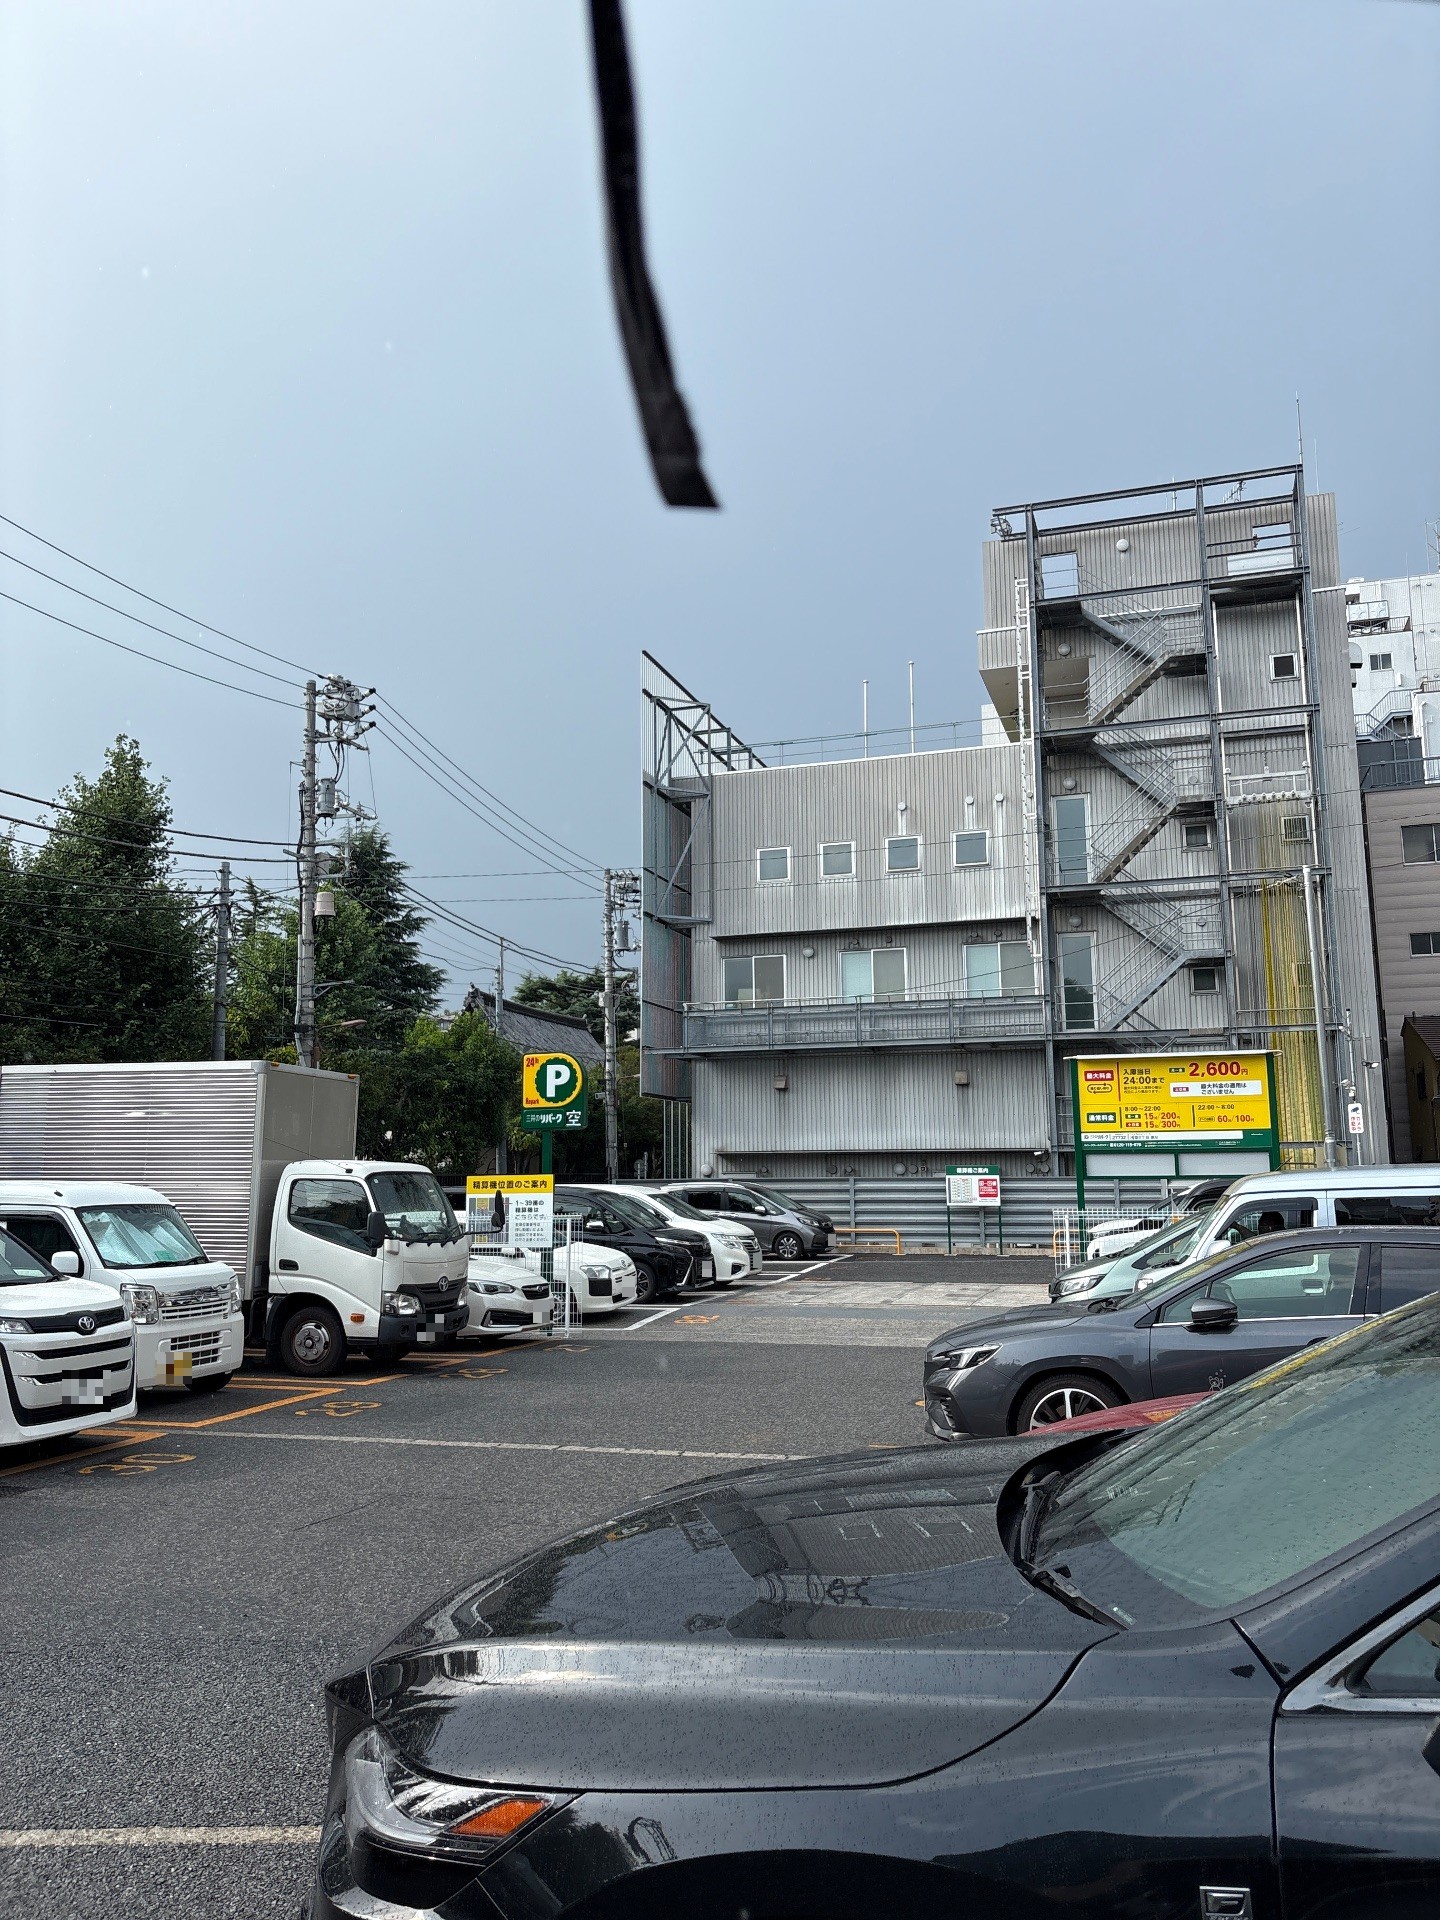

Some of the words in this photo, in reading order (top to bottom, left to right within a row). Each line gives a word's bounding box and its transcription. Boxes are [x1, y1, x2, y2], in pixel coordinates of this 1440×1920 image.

[1123, 1068, 1151, 1076] 入庫当日
[1189, 1061, 1248, 1077] 2,600円
[1086, 1071, 1112, 1079] 最大料金
[546, 1064, 571, 1098] P
[1123, 1076, 1165, 1085] 24:00まで
[1200, 1082, 1247, 1090] 最大料金の適用は
[525, 1097, 540, 1105] Repark
[526, 1113, 562, 1124] 三井のリパーク
[566, 1110, 582, 1126] 空
[1088, 1114, 1114, 1122] 通常料金
[472, 1179, 548, 1190] 精算機位置のご案内
[78, 1452, 197, 1476] 30
